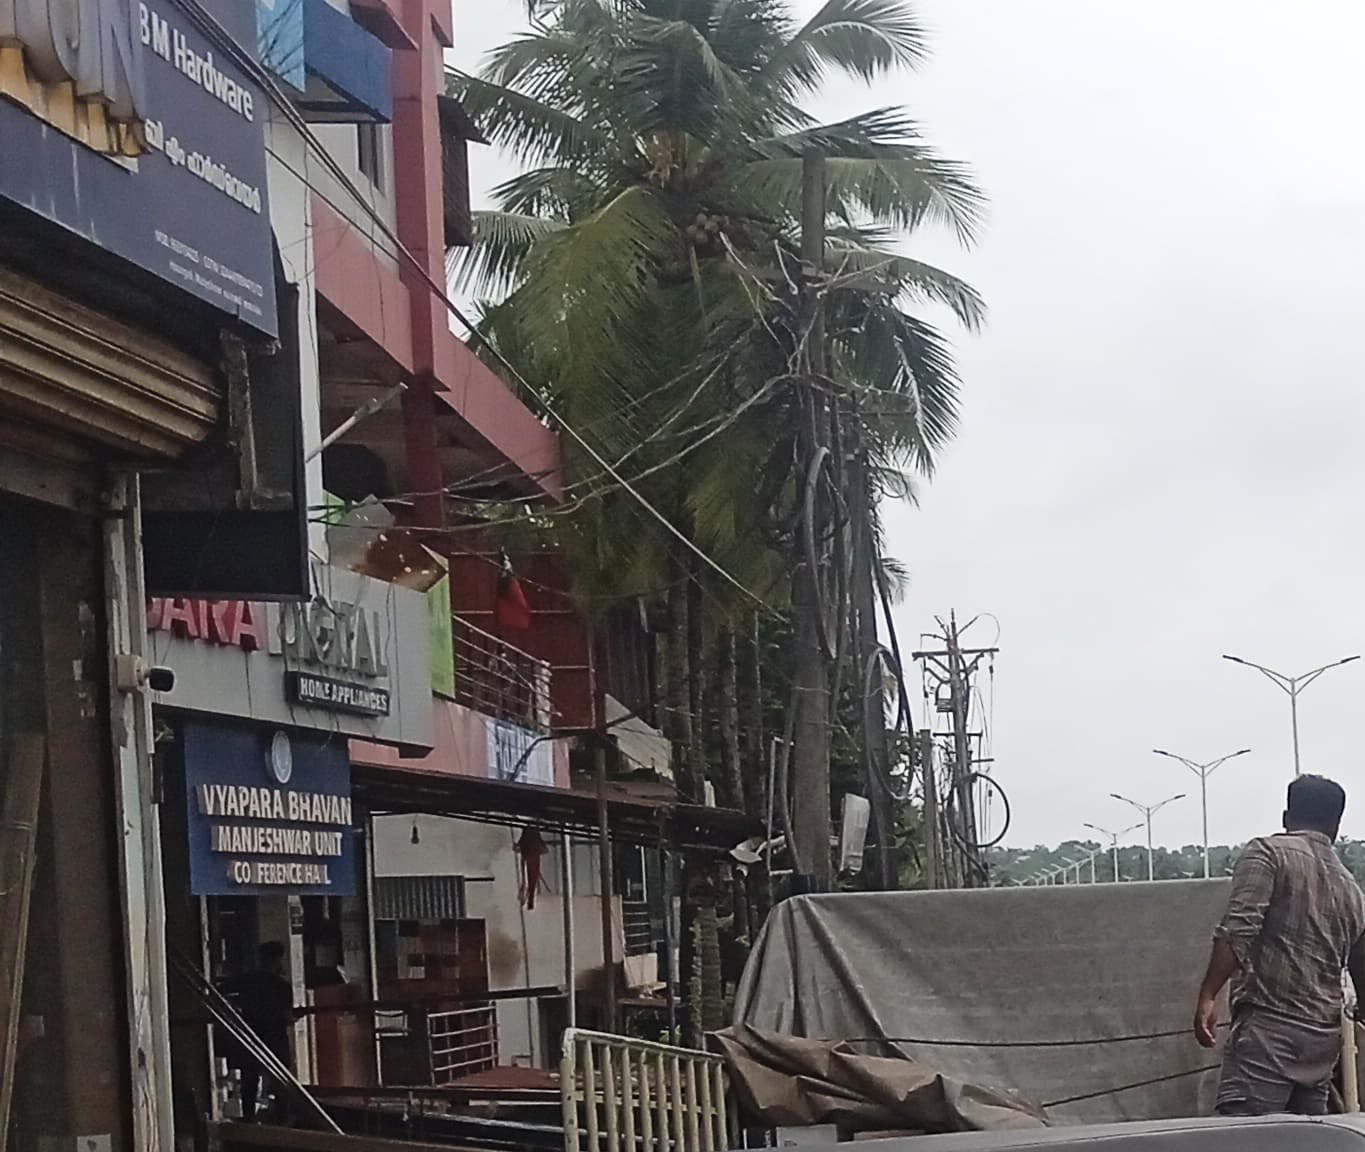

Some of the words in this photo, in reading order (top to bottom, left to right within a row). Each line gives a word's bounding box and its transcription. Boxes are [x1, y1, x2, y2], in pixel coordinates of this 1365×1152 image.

[173, 28, 254, 123] Hardware
[203, 784, 285, 819] VYAPARA
[288, 790, 353, 826] BHAVAN
[218, 825, 312, 856] MANJESHWAR
[314, 831, 343, 857] UNIT
